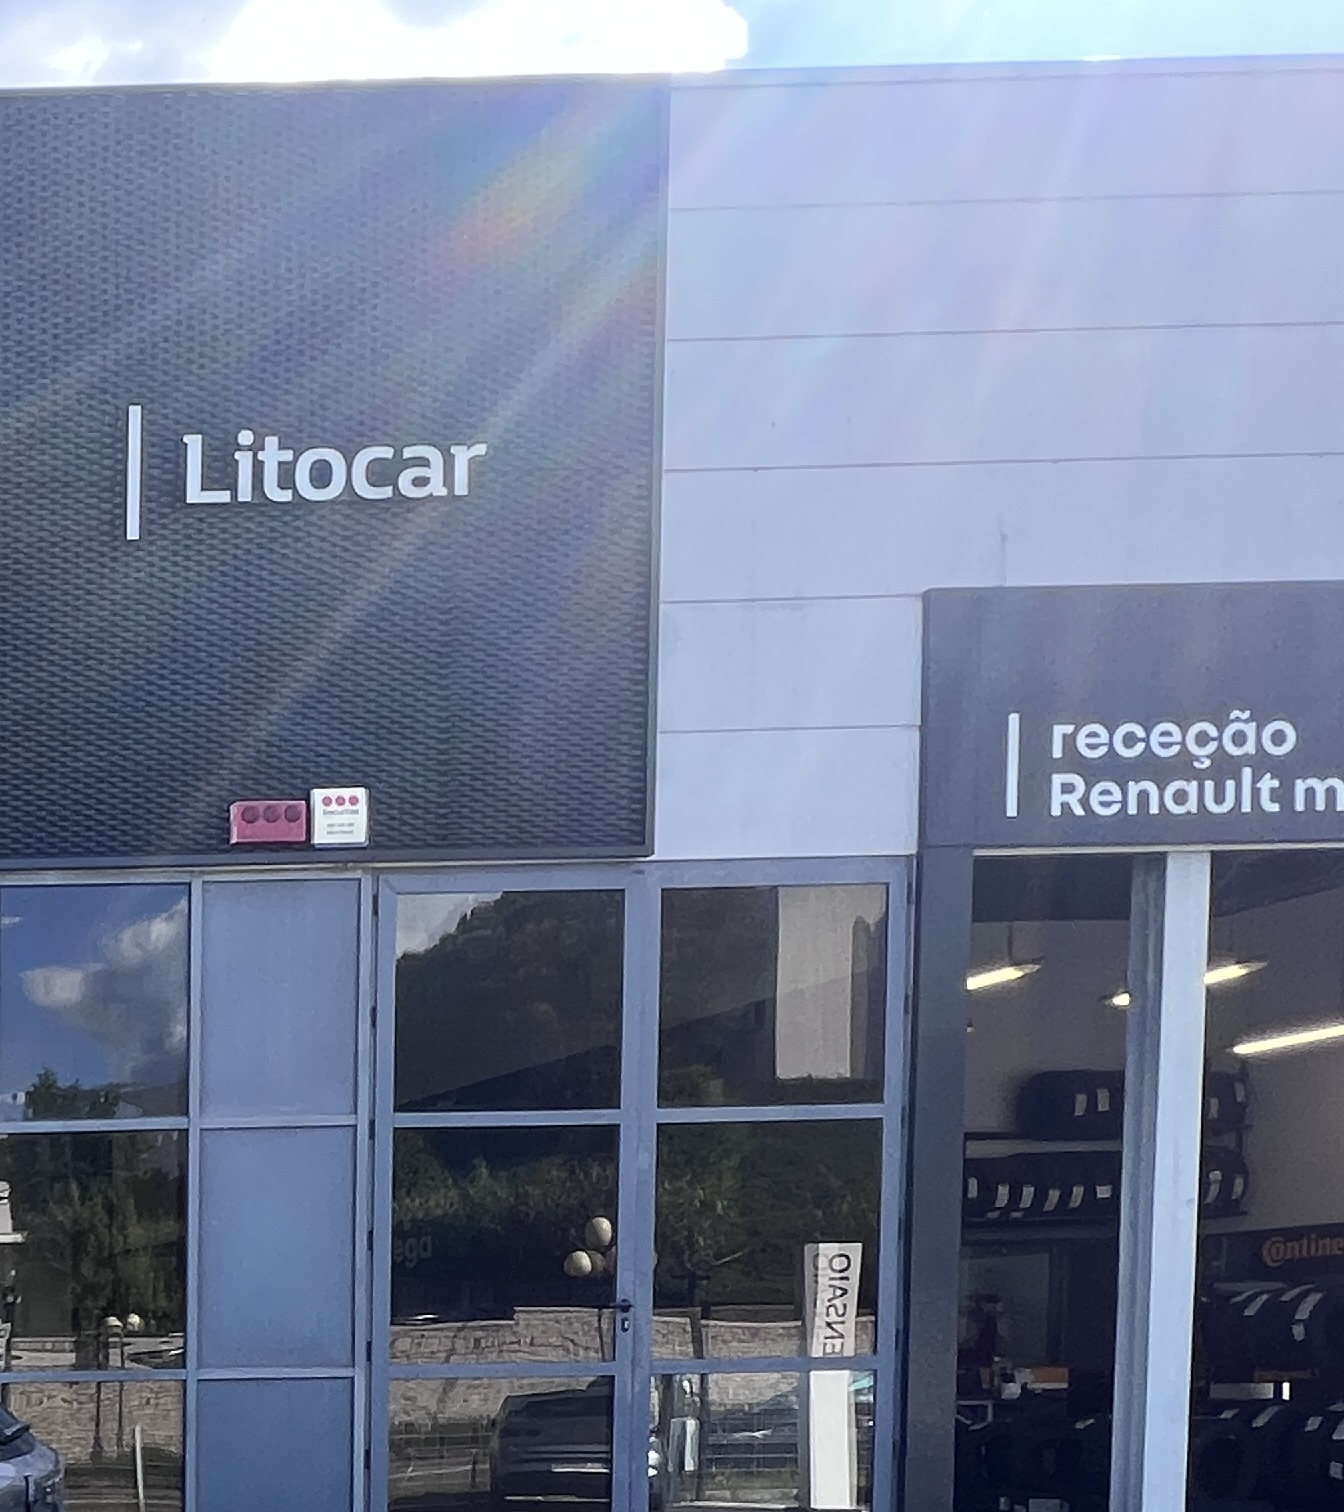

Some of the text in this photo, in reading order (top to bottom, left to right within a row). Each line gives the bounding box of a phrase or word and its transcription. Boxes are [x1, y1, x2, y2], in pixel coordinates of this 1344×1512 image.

[183, 429, 487, 504] Litocar
[1051, 709, 1298, 768] receção
[1049, 767, 1281, 816] Renault
